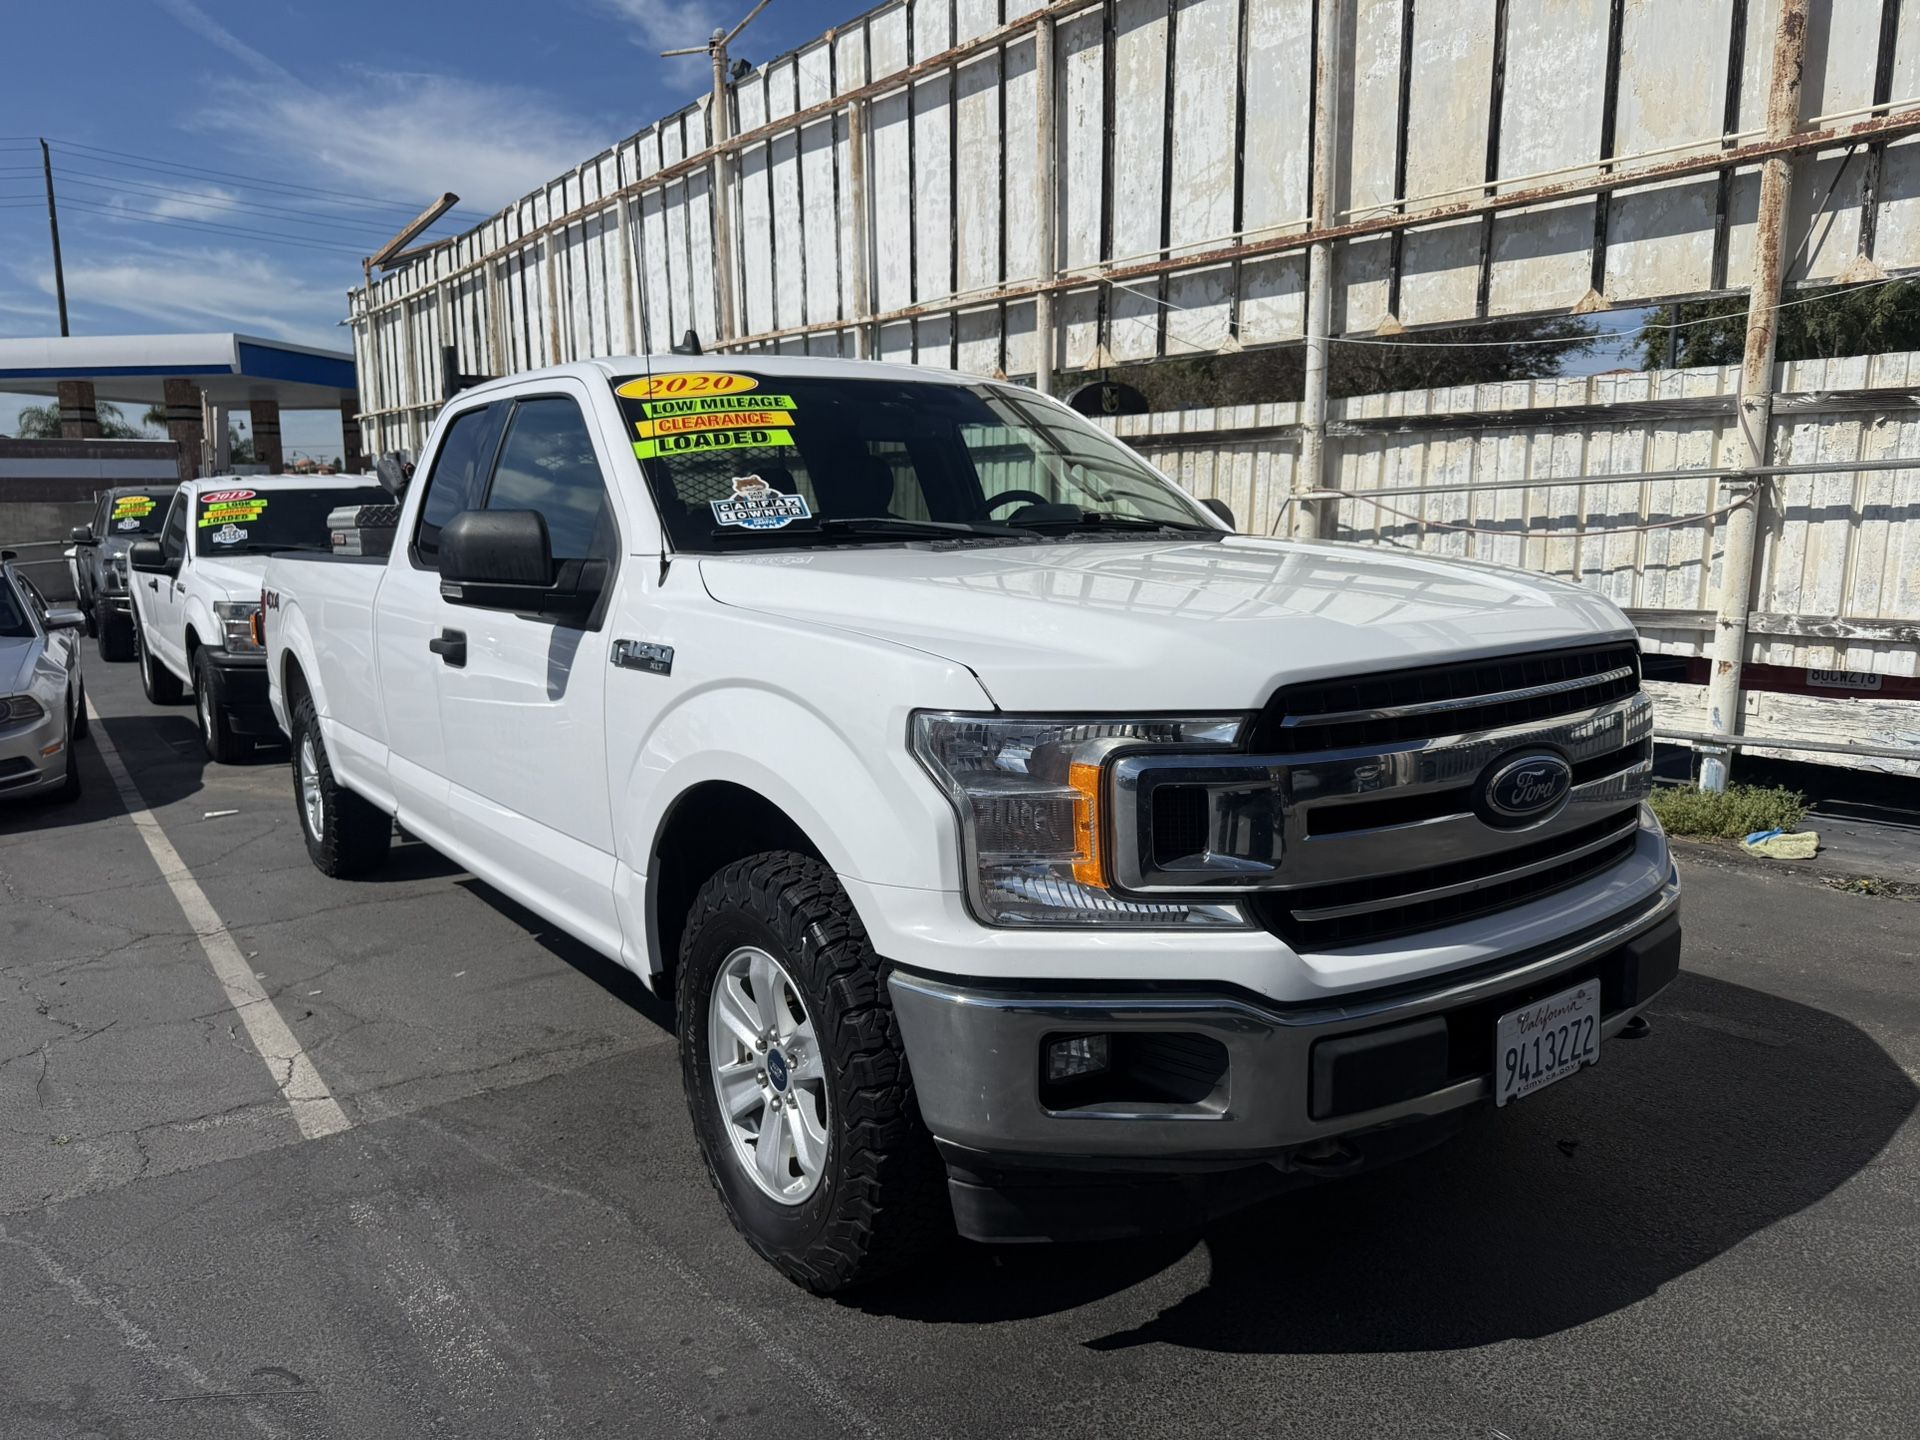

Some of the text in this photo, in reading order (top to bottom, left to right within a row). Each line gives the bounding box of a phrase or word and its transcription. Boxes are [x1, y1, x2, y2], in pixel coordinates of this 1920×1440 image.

[642, 376, 734, 396] 2020
[652, 396, 787, 415] LOW MILEAGE
[659, 412, 773, 432] CLEARANCE
[659, 430, 771, 452] LOADED
[210, 491, 247, 502] 2019
[720, 499, 798, 511] CARFAX
[207, 515, 248, 524] LOADED
[737, 508, 801, 519] OWNER
[650, 662, 663, 671] XLT
[1512, 769, 1563, 805] Ford
[1520, 1000, 1583, 1034] California
